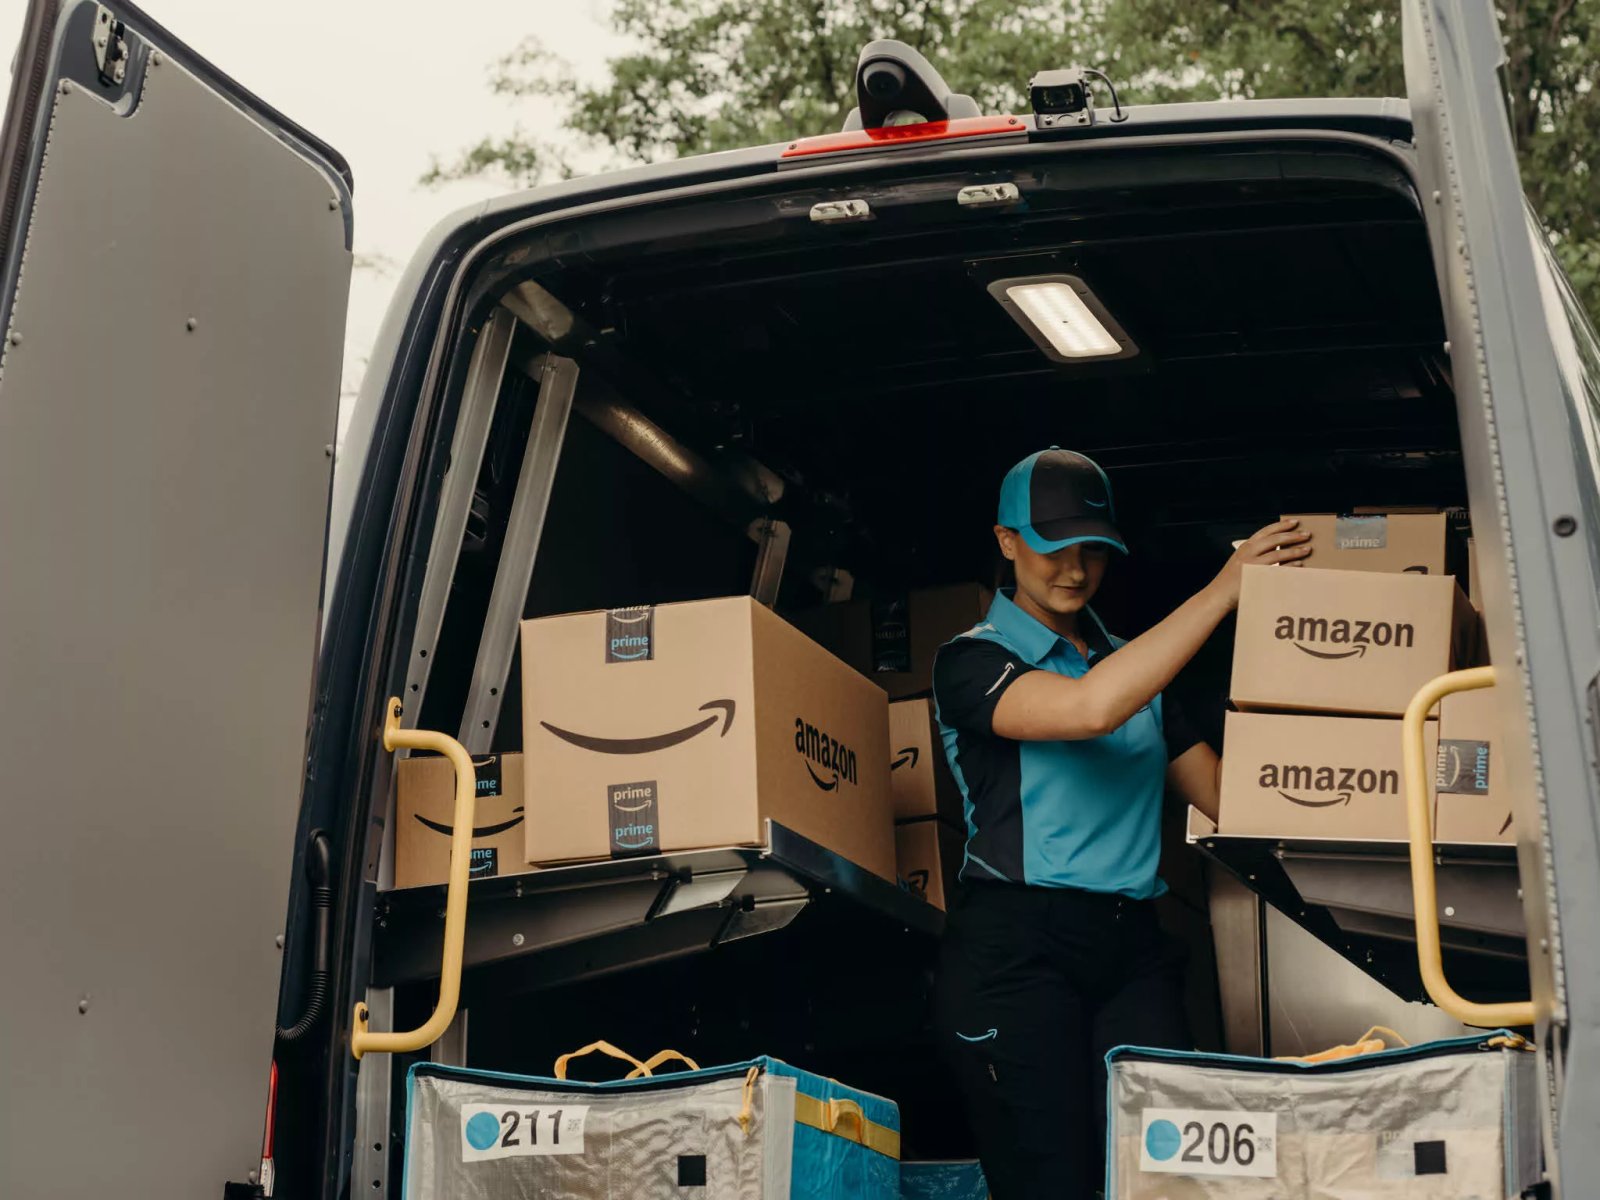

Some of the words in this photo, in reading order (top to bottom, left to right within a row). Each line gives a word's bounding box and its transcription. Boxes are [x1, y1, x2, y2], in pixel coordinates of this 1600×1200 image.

[611, 634, 649, 651] prime
[1275, 615, 1415, 648] amazon
[795, 717, 857, 786] amazon
[1436, 745, 1448, 787] prime
[1473, 747, 1488, 789] prime
[613, 784, 652, 804] prime
[1259, 763, 1399, 795] amazon
[614, 821, 654, 842] prime
[500, 1108, 564, 1147] 211
[1181, 1120, 1256, 1166] 206
